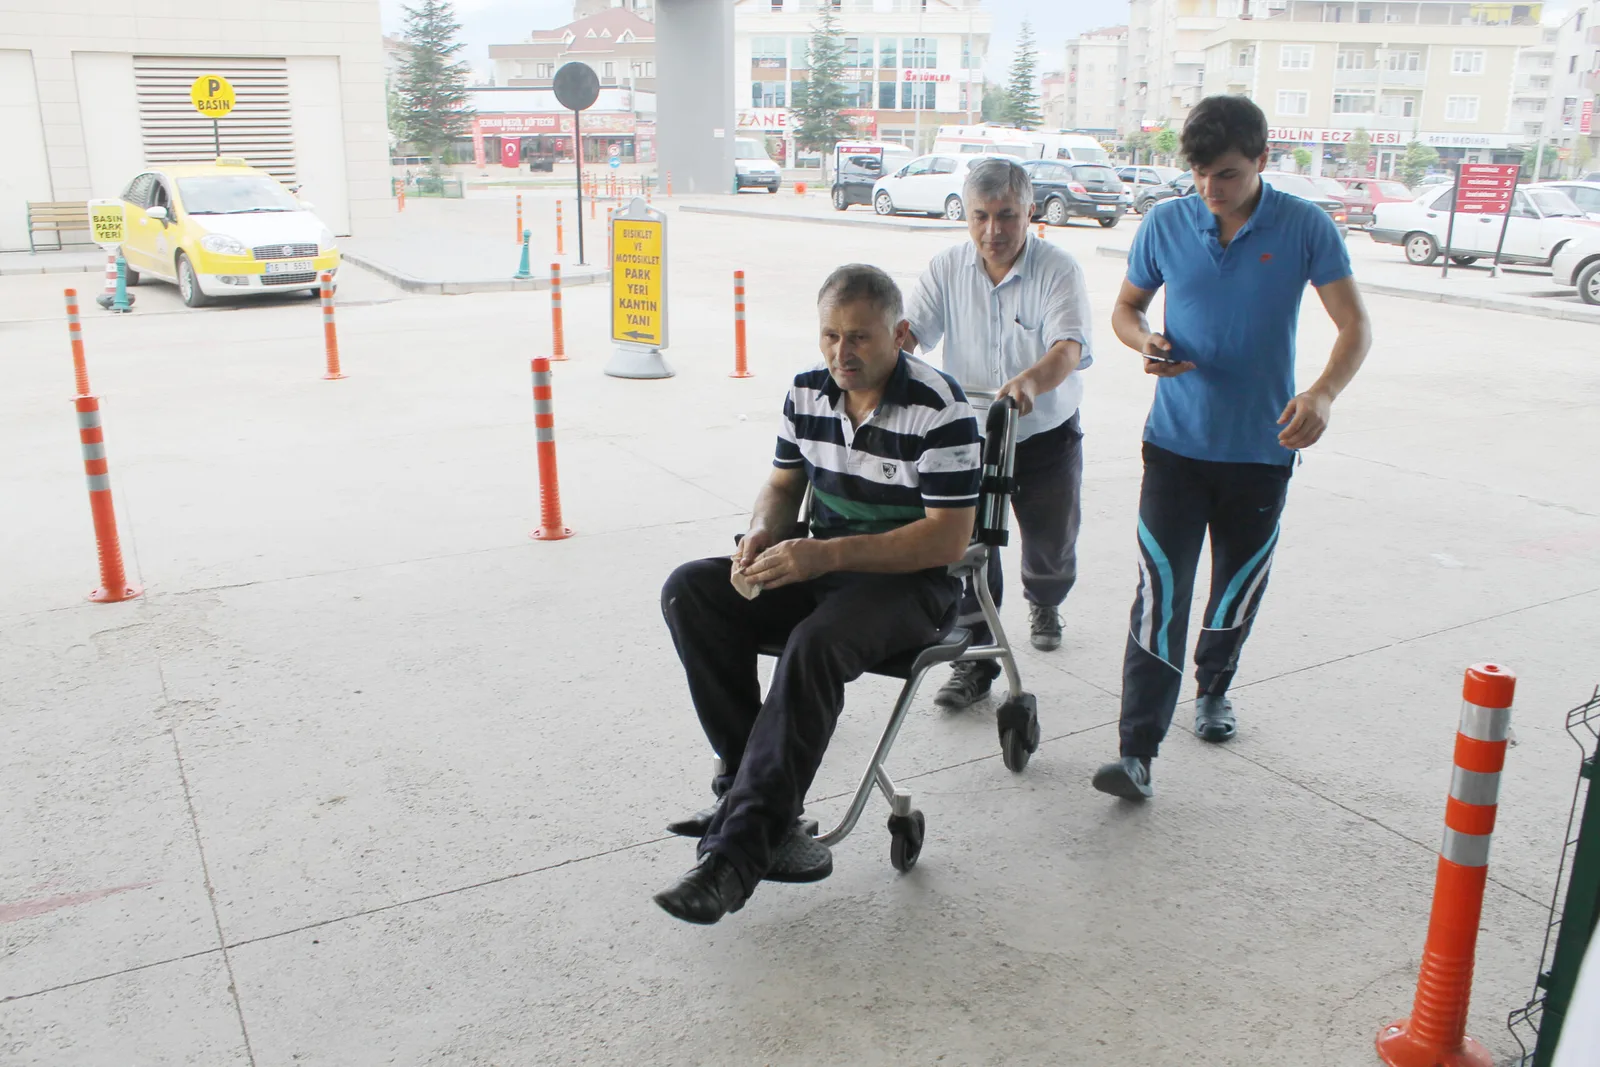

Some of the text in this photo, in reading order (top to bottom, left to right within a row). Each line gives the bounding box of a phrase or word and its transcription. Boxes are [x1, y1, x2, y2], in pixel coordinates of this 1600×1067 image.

[208, 79, 220, 97] P
[197, 100, 230, 110] BASIN
[93, 215, 123, 223] BASIN
[96, 223, 122, 231] PARK
[634, 242, 642, 251] VE
[625, 268, 651, 281] PARK
[626, 313, 650, 327] YANI
